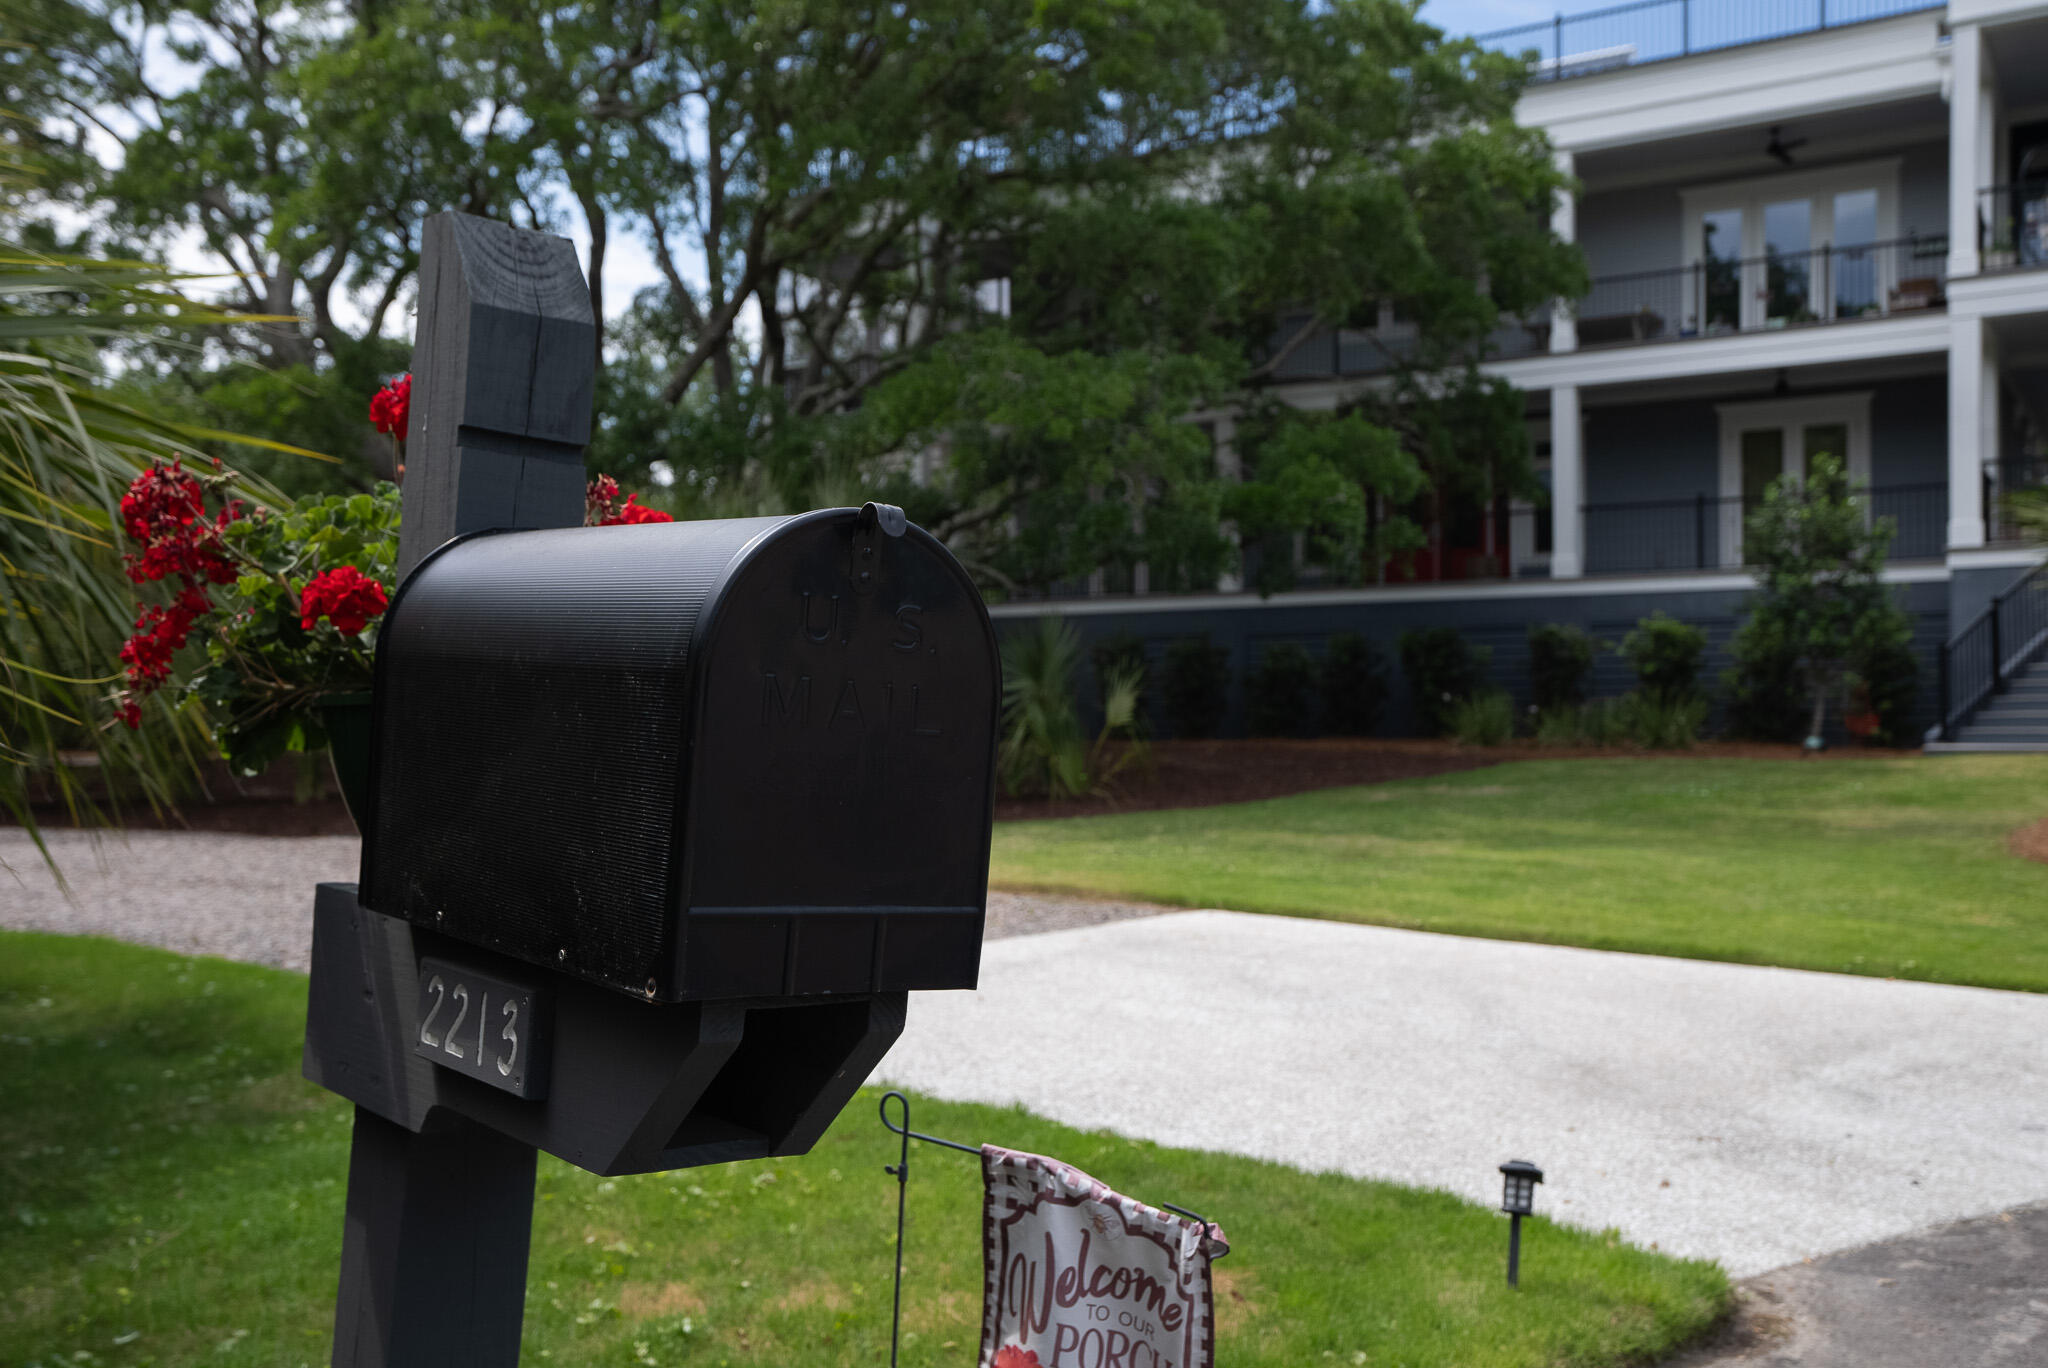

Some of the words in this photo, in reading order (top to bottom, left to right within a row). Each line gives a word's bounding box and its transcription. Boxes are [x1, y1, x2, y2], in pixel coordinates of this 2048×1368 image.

[760, 672, 944, 738] MAIL
[420, 975, 519, 1077] 2213
[1008, 1227, 1184, 1345] Welcome
[1086, 1303, 1110, 1322] TO
[1118, 1311, 1155, 1341] OUR
